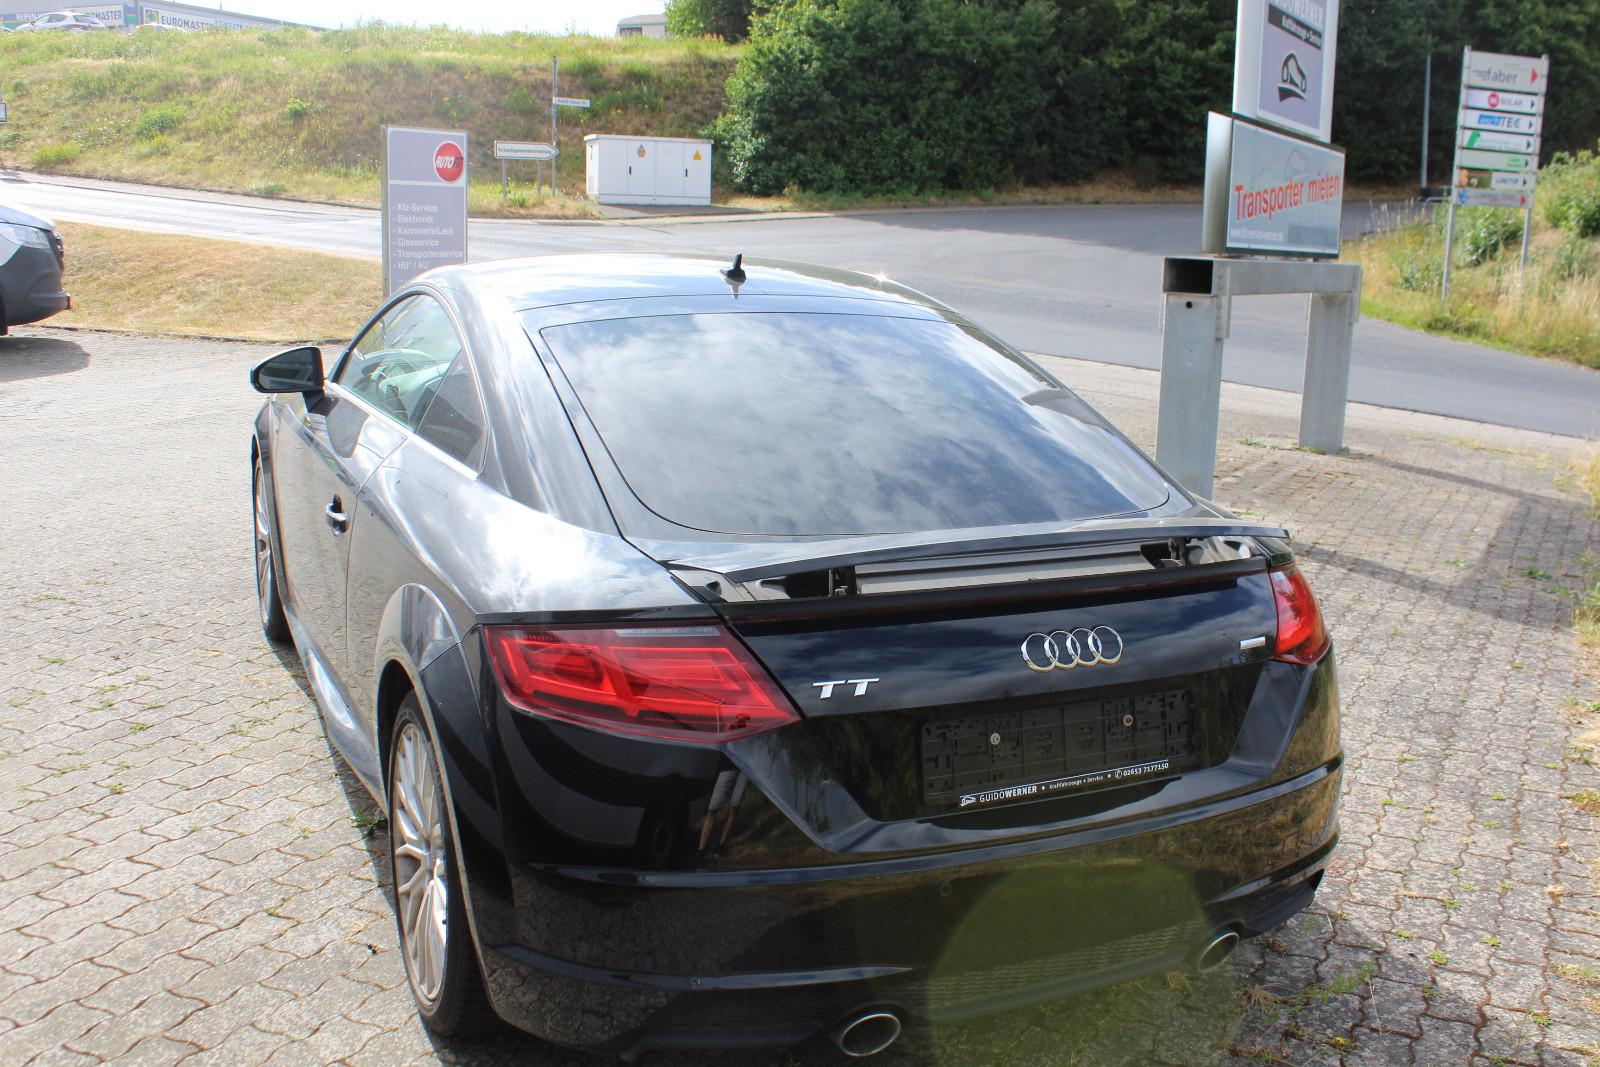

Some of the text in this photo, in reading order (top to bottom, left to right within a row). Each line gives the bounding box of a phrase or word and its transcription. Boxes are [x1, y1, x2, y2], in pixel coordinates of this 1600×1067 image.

[1487, 66, 1518, 83] faber
[1234, 171, 1340, 221] Transporter mieten
[397, 203, 438, 212] Kfz-Service
[397, 215, 433, 223] Elektronik
[398, 238, 439, 247] Glasservice
[812, 678, 880, 700] TT
[979, 785, 1038, 802] GUIDOWERNER
[1123, 767, 1142, 777] 02653
